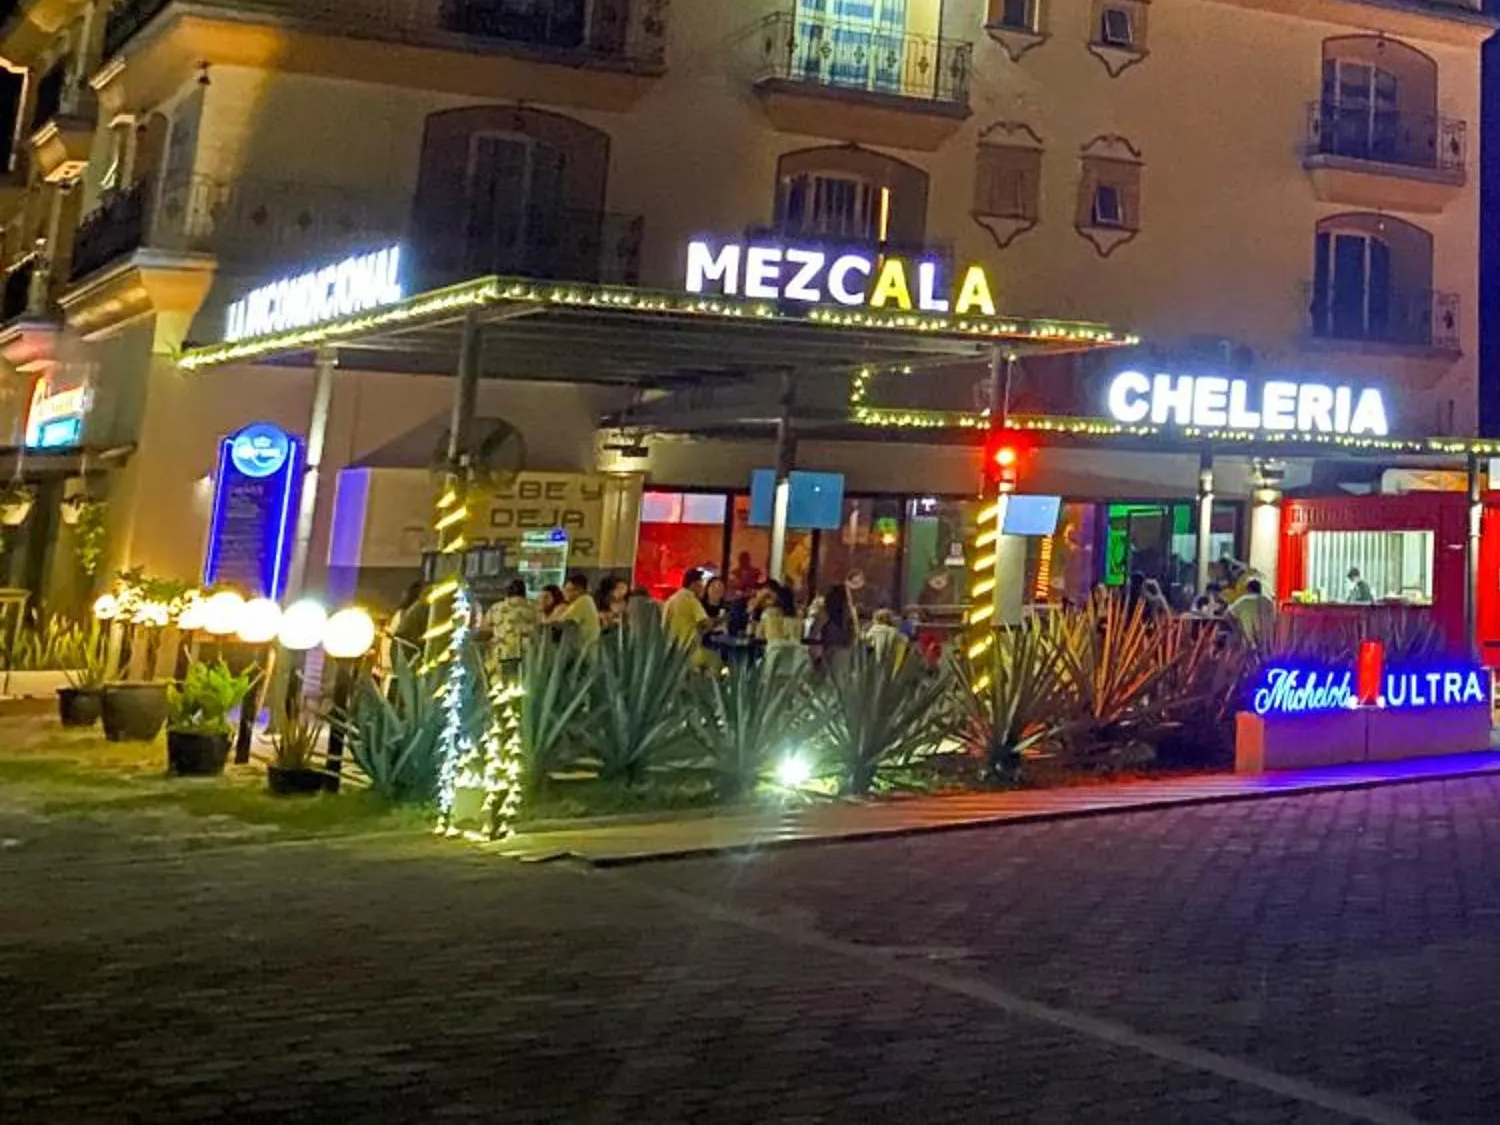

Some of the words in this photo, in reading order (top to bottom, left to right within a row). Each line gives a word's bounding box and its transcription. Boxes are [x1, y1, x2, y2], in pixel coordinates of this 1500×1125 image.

[685, 241, 996, 315] MEZCALA
[1108, 371, 1389, 436] CHELERIA
[490, 507, 586, 529] DEJA
[1254, 668, 1353, 715] Michelob
[1387, 671, 1484, 706] ULTRA
